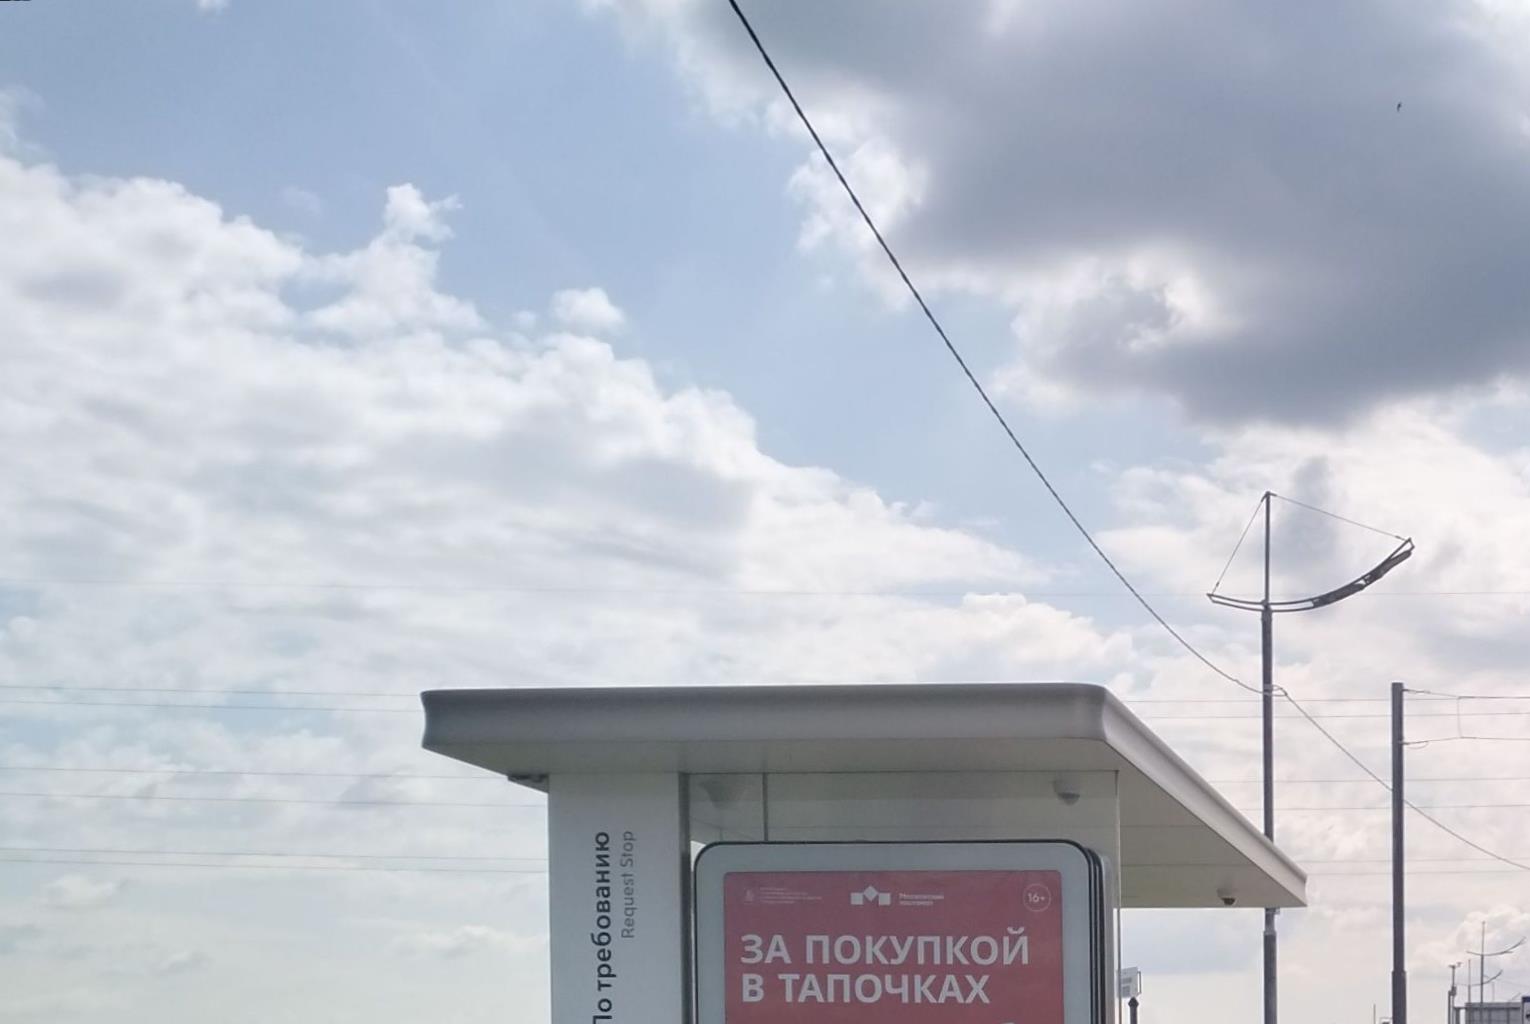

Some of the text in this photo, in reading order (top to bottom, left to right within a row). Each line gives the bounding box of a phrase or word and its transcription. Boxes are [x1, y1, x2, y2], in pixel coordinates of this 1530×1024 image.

[619, 830, 638, 939] Request Stop
[1027, 892, 1045, 903] 16+
[590, 831, 617, 991] требованию
[740, 926, 1029, 965] ЗА ПОКУПКОЙ
[741, 973, 991, 1004] В ТАПОЧКАХ
